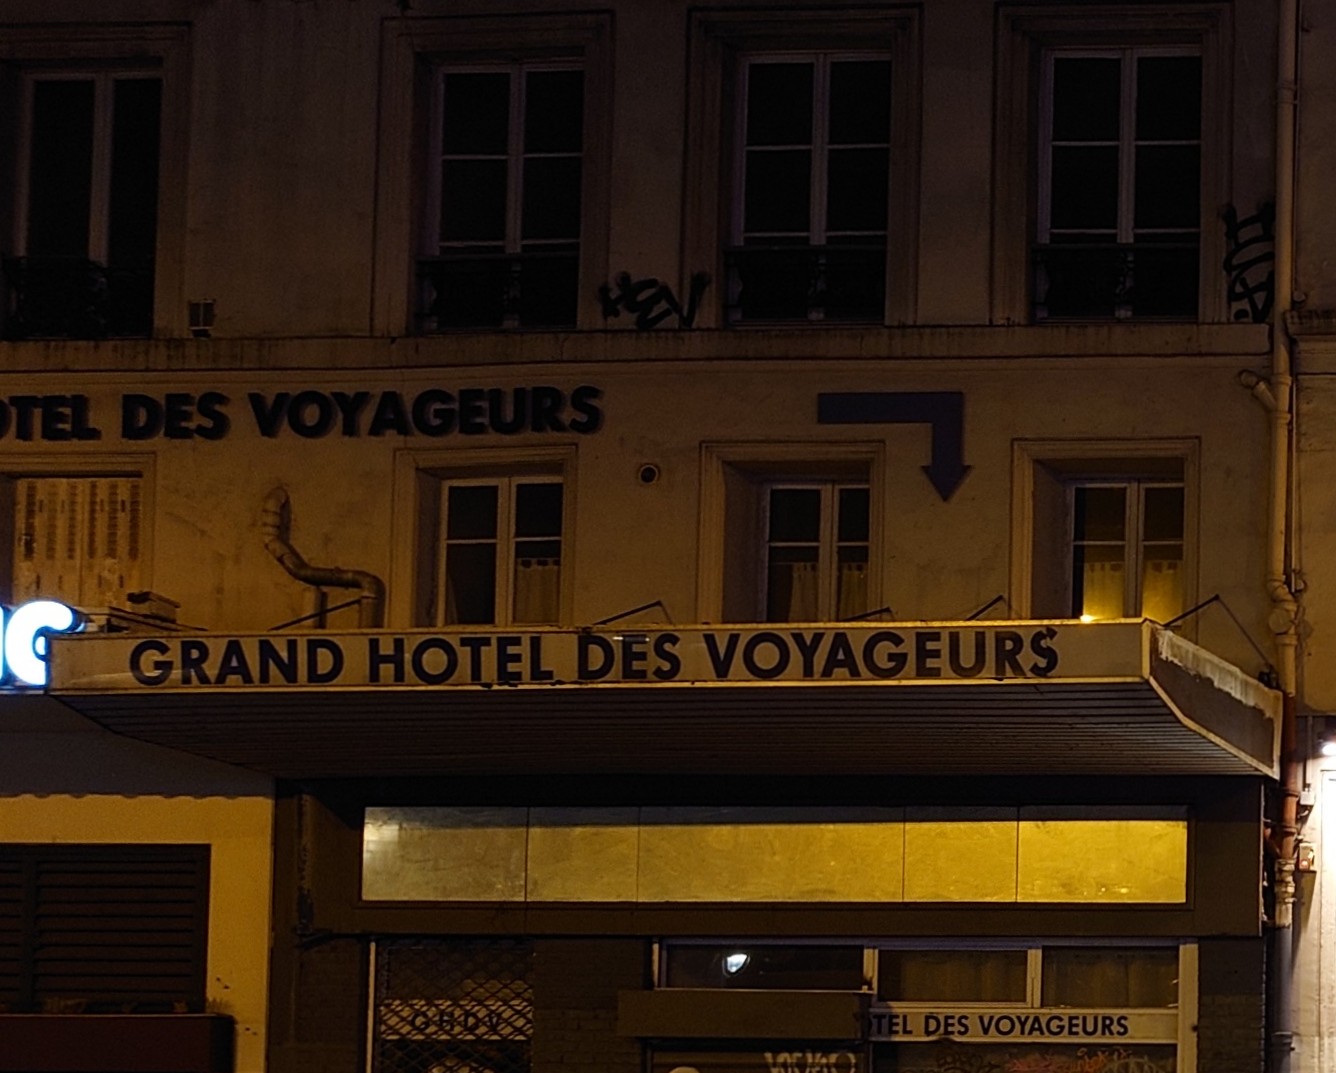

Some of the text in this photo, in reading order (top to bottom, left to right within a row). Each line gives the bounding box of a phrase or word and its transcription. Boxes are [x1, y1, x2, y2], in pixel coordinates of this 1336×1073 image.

[0, 385, 604, 441] TEL DES VOYAGEURS
[129, 629, 1060, 686] GRAND HOTEL DES VOYAGEURS
[869, 1014, 1130, 1038] TEL DES VOYAGEURS
